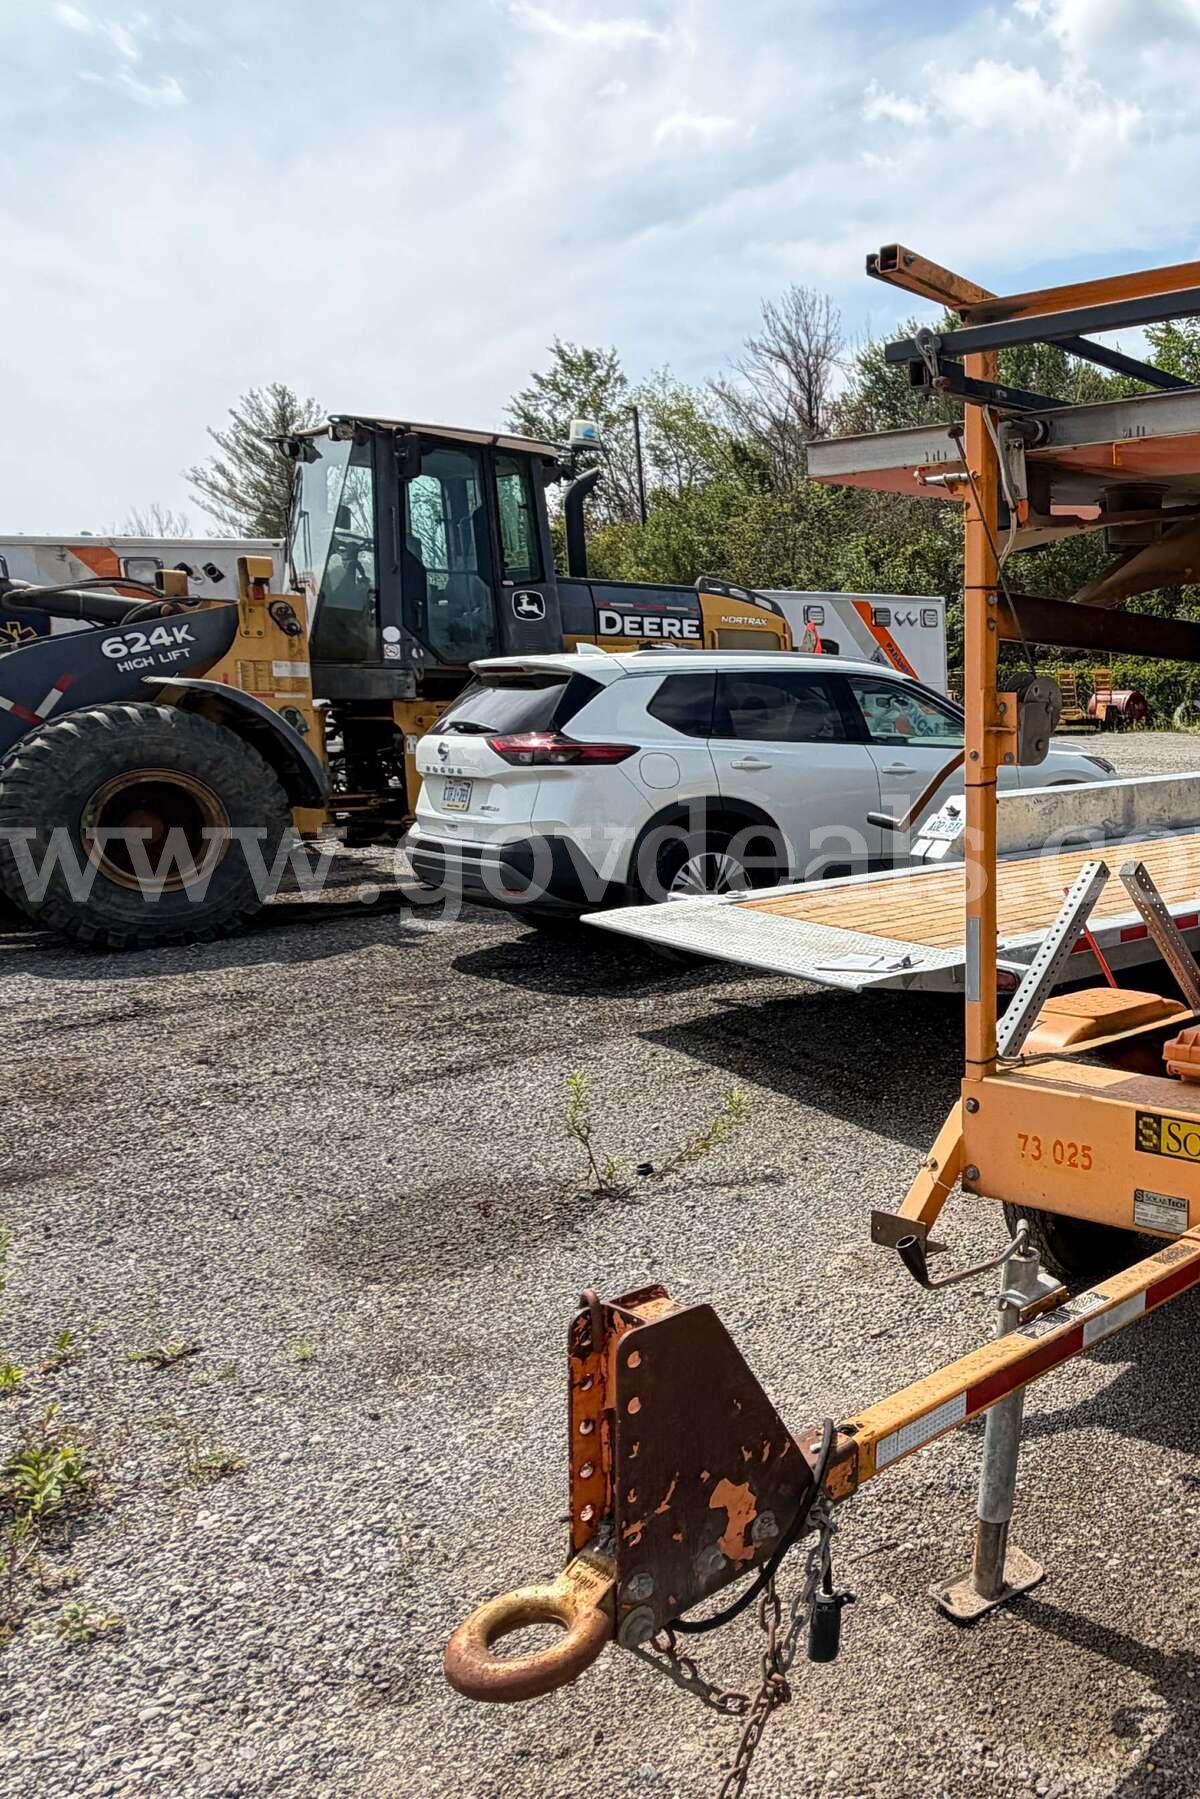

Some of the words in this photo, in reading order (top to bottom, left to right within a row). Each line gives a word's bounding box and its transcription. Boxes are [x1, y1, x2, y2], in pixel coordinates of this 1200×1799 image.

[598, 610, 700, 639] DEERE
[721, 615, 768, 626] NORTRAX
[101, 623, 196, 659] 624K
[117, 654, 155, 673] HIGH
[158, 648, 190, 665] LIFT
[1017, 1132, 1042, 1161] 73
[1052, 1139, 1093, 1171] 025
